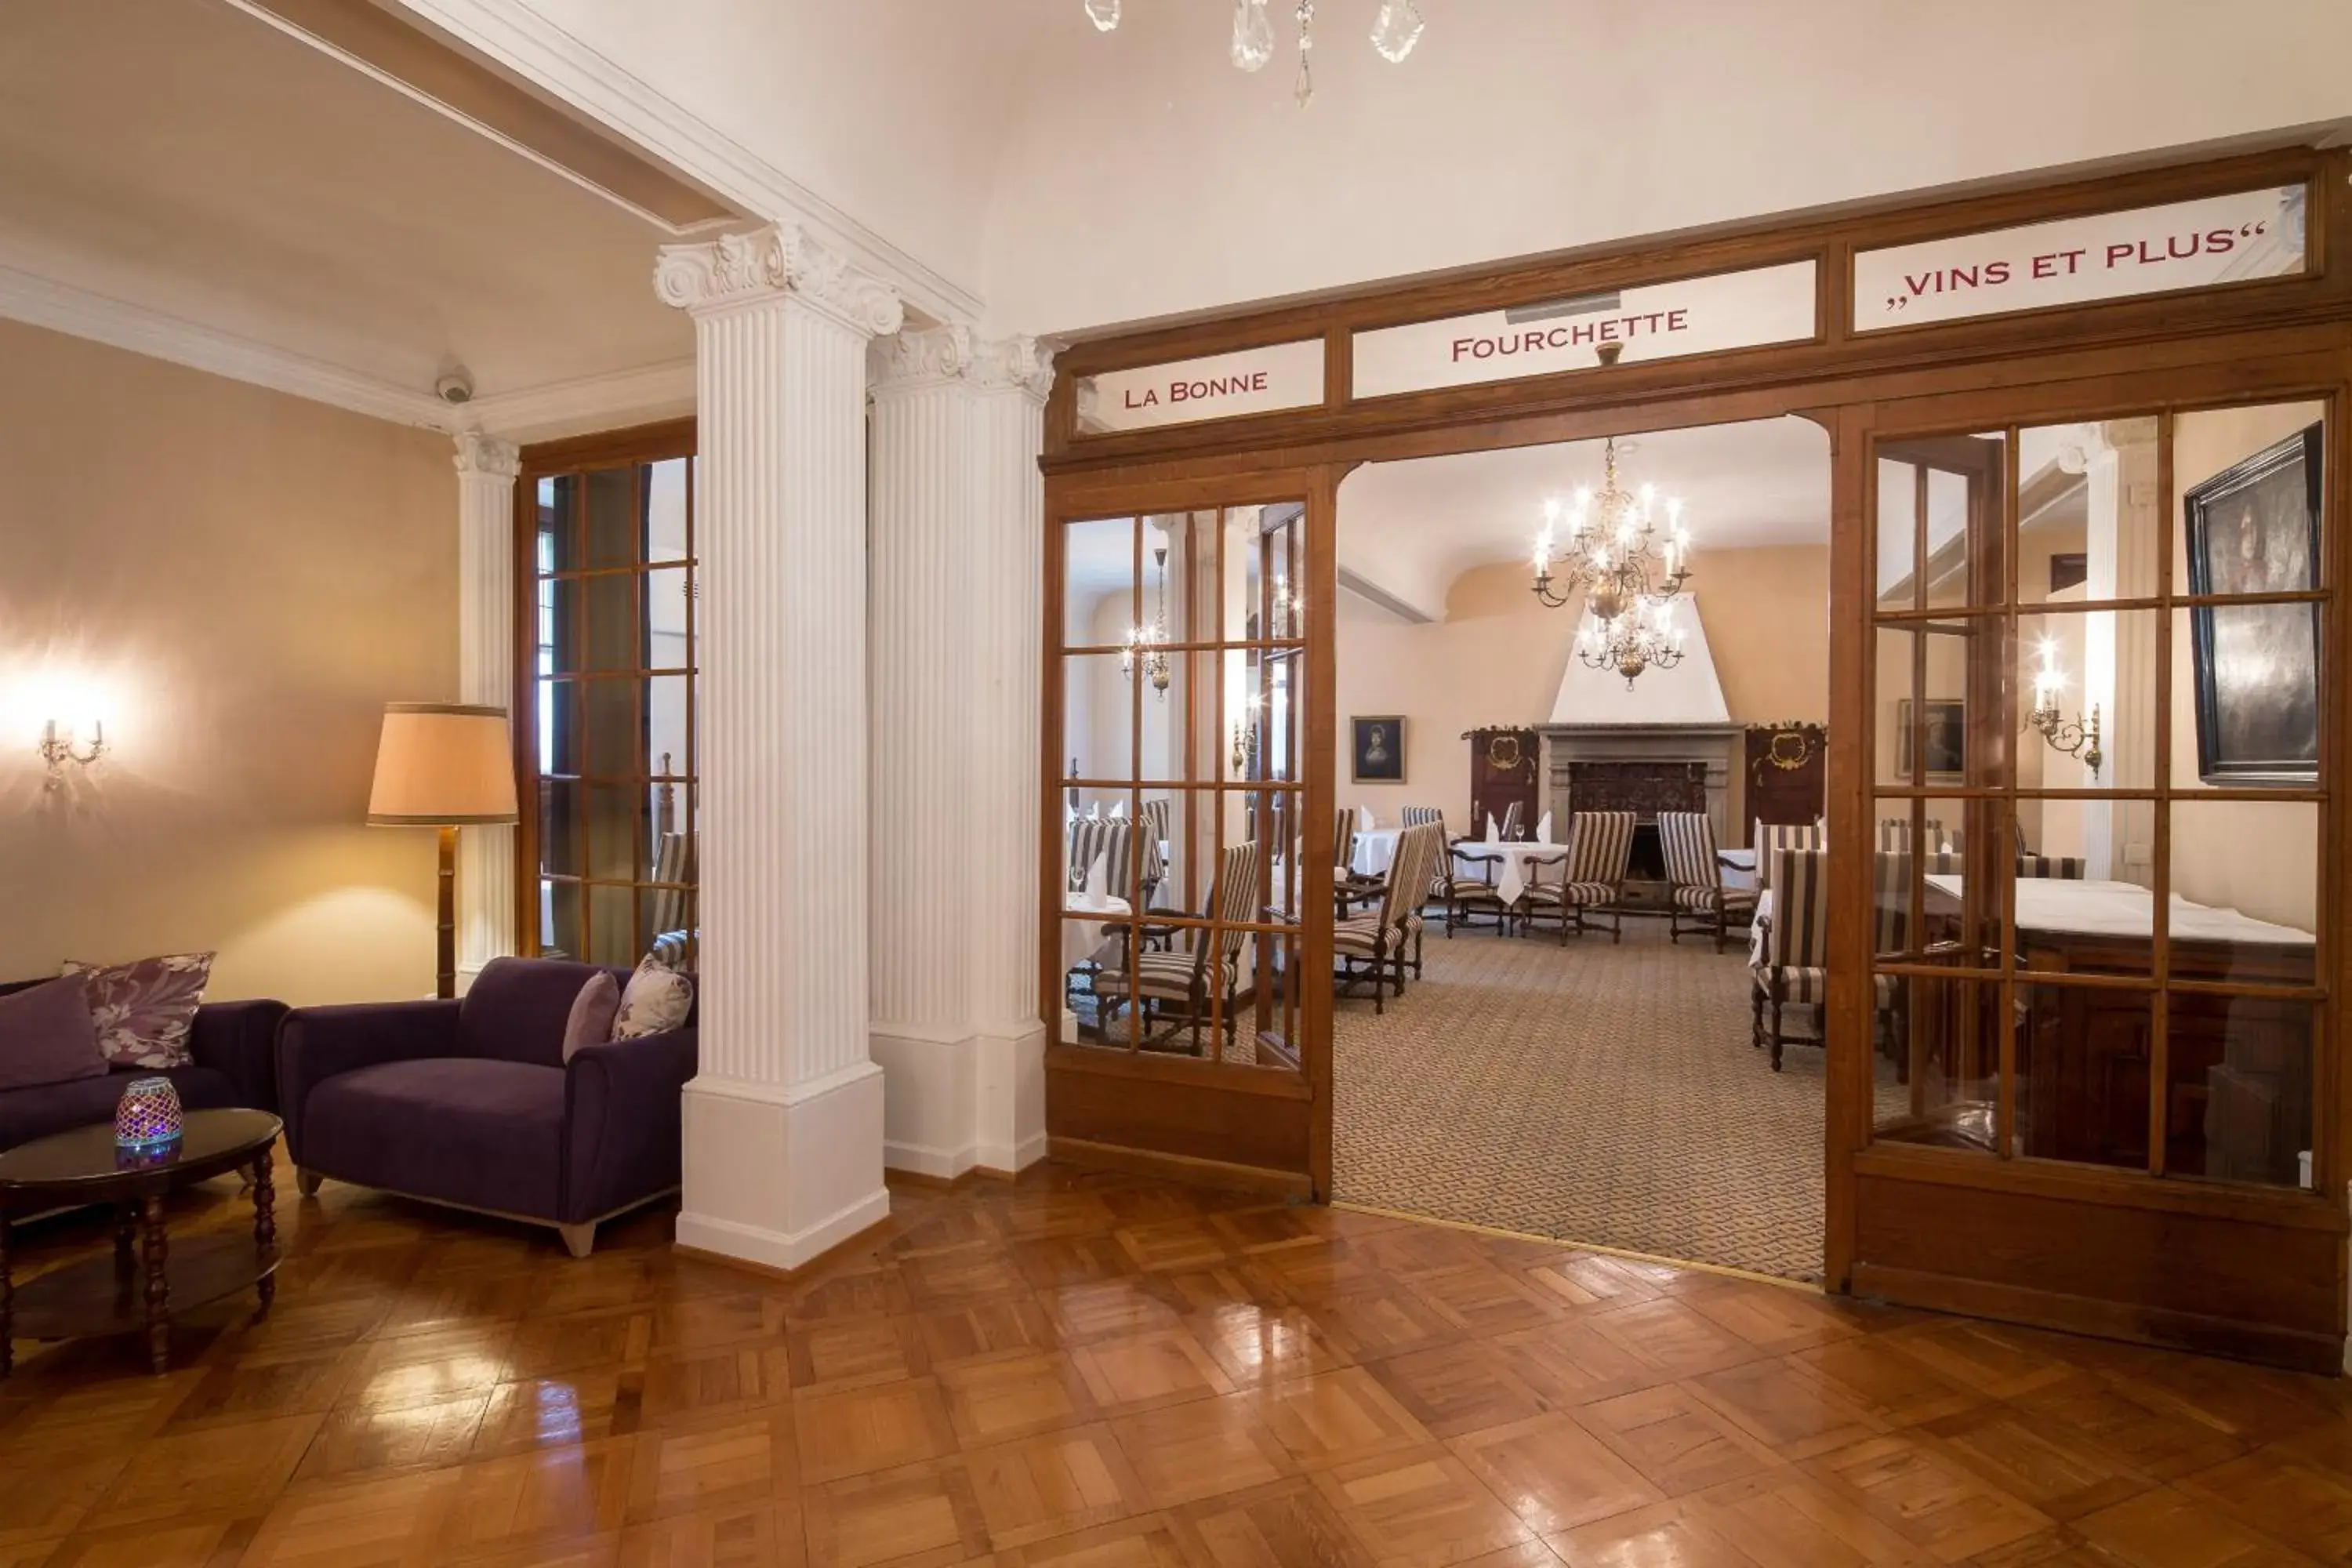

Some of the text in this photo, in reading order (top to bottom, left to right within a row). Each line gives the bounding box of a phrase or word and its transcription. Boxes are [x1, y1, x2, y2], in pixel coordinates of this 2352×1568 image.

[2031, 249, 2087, 279] ET
[1452, 308, 1689, 362] FOURCHETTE
[1170, 372, 1269, 403] BONNE
